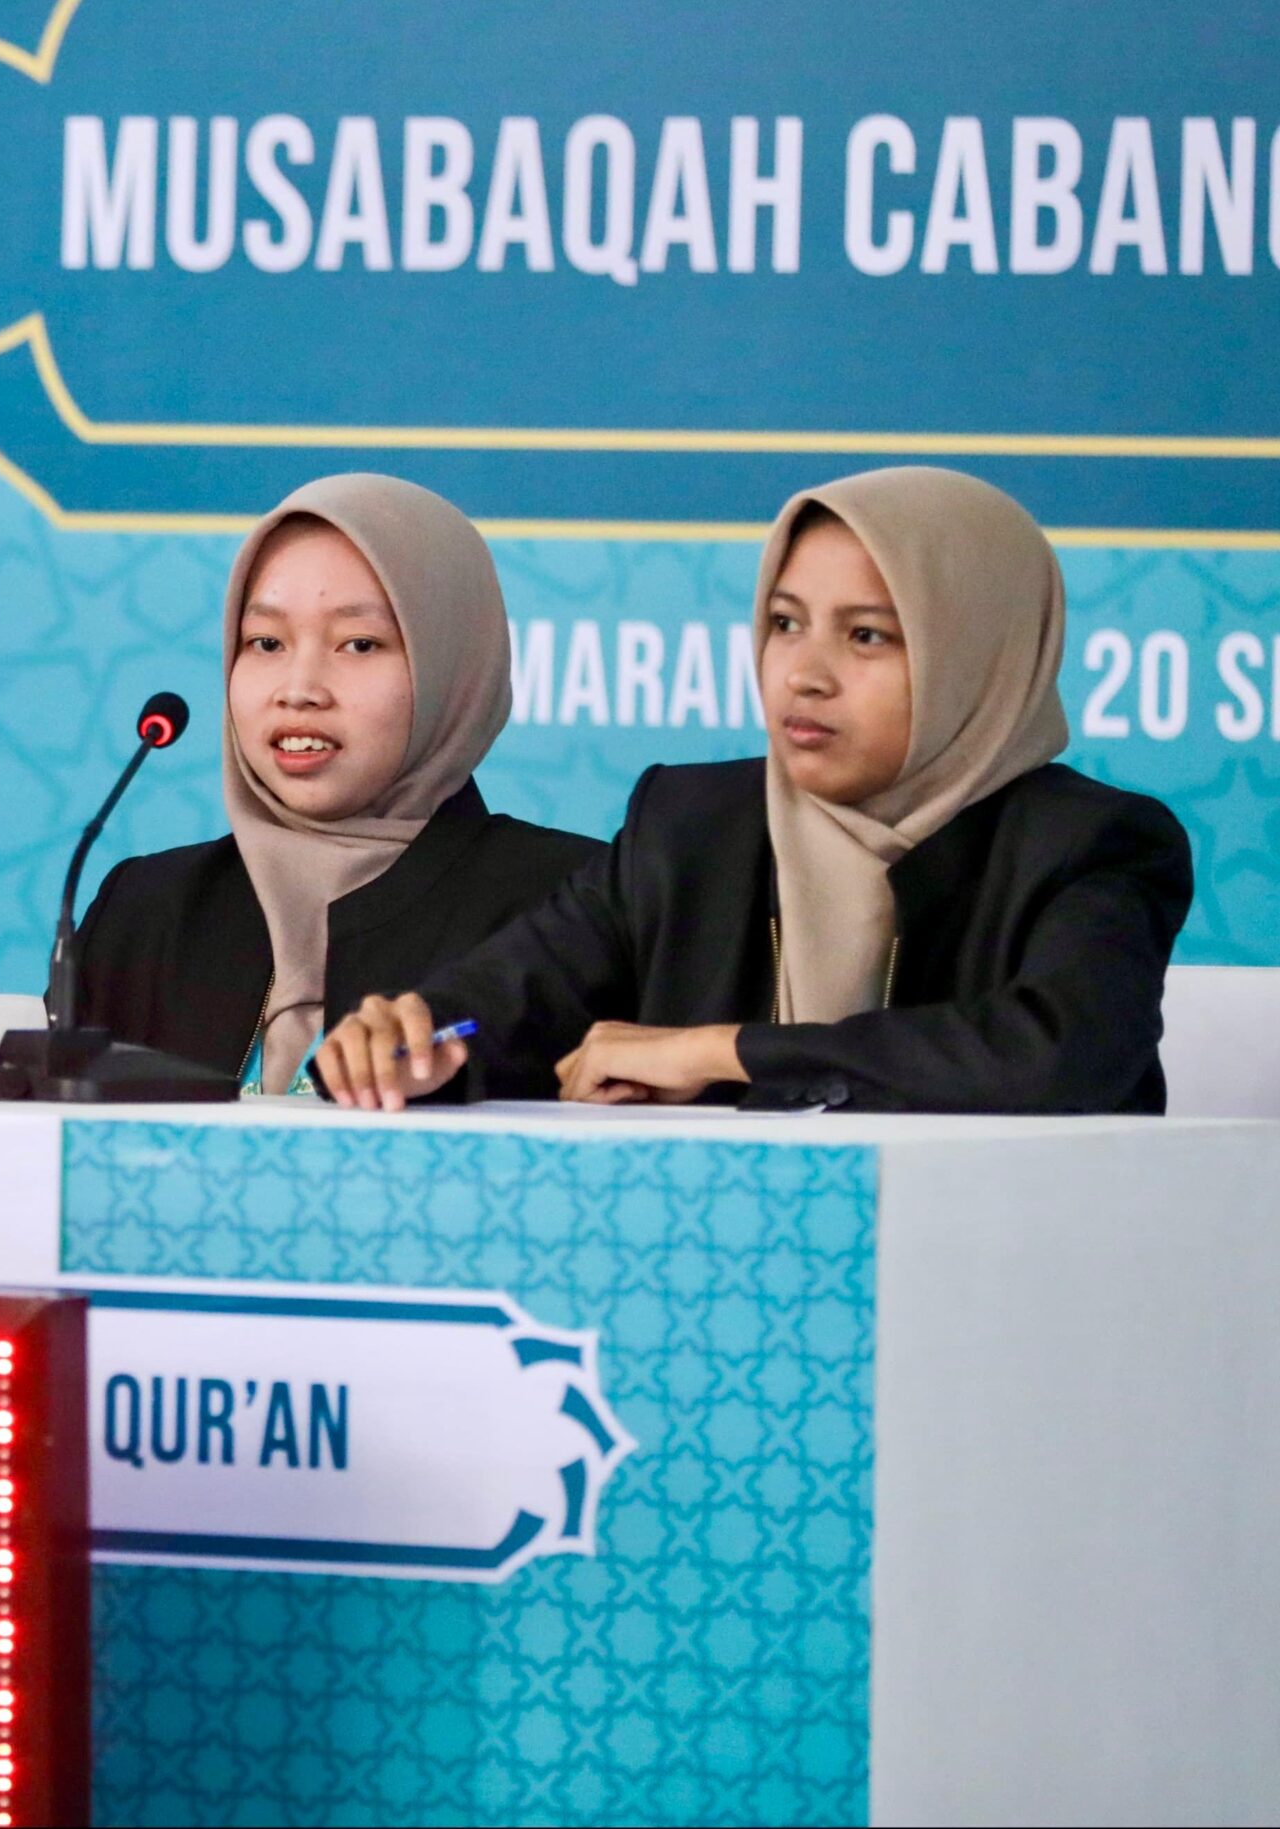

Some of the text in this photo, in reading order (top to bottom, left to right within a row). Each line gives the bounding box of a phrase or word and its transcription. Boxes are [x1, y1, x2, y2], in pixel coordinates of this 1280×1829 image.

[61, 114, 1280, 285] MUSABAQAH CABAN
[1082, 628, 1189, 740] 20
[1215, 631, 1280, 741] S
[103, 1373, 349, 1472] QUR'AN
